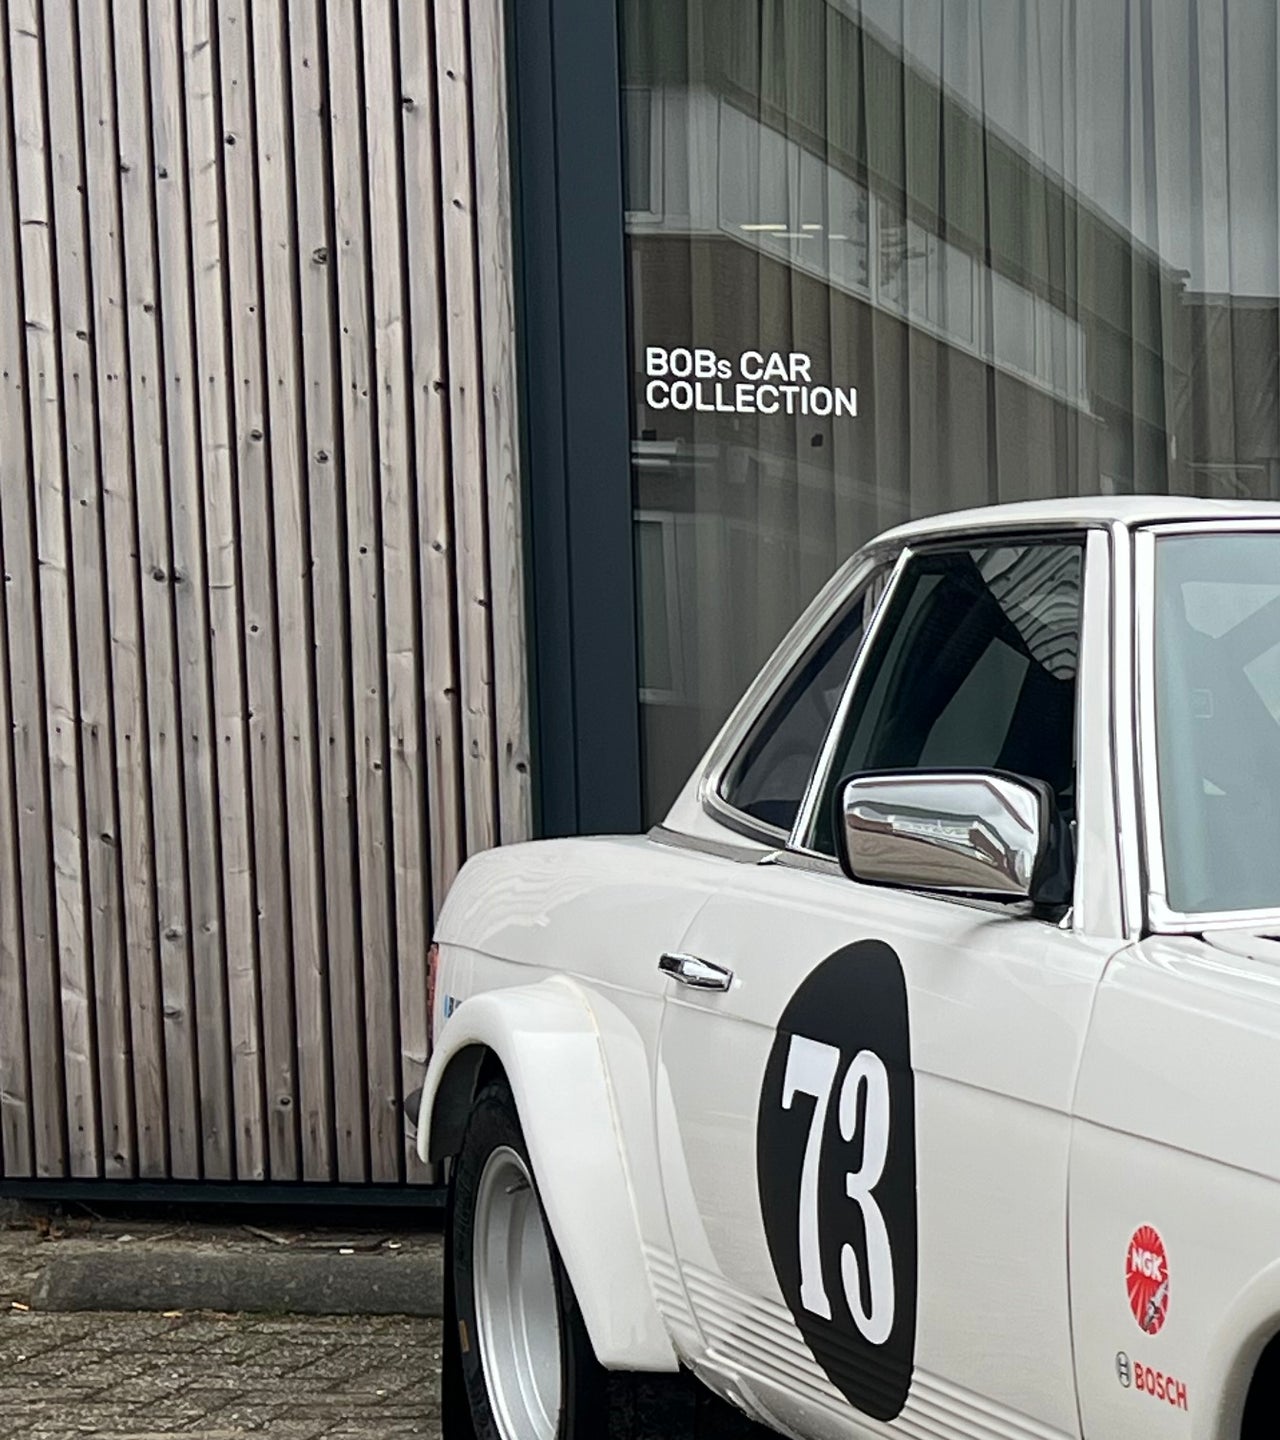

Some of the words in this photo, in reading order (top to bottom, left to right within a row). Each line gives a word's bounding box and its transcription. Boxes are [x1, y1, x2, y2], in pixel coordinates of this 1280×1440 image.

[645, 346, 732, 380] BOBs
[739, 350, 812, 384] CAR
[645, 381, 859, 418] COLLECTION
[781, 1034, 896, 1346] 73
[1130, 1247, 1165, 1282] NGK
[1133, 1361, 1189, 1411] BOSCH
